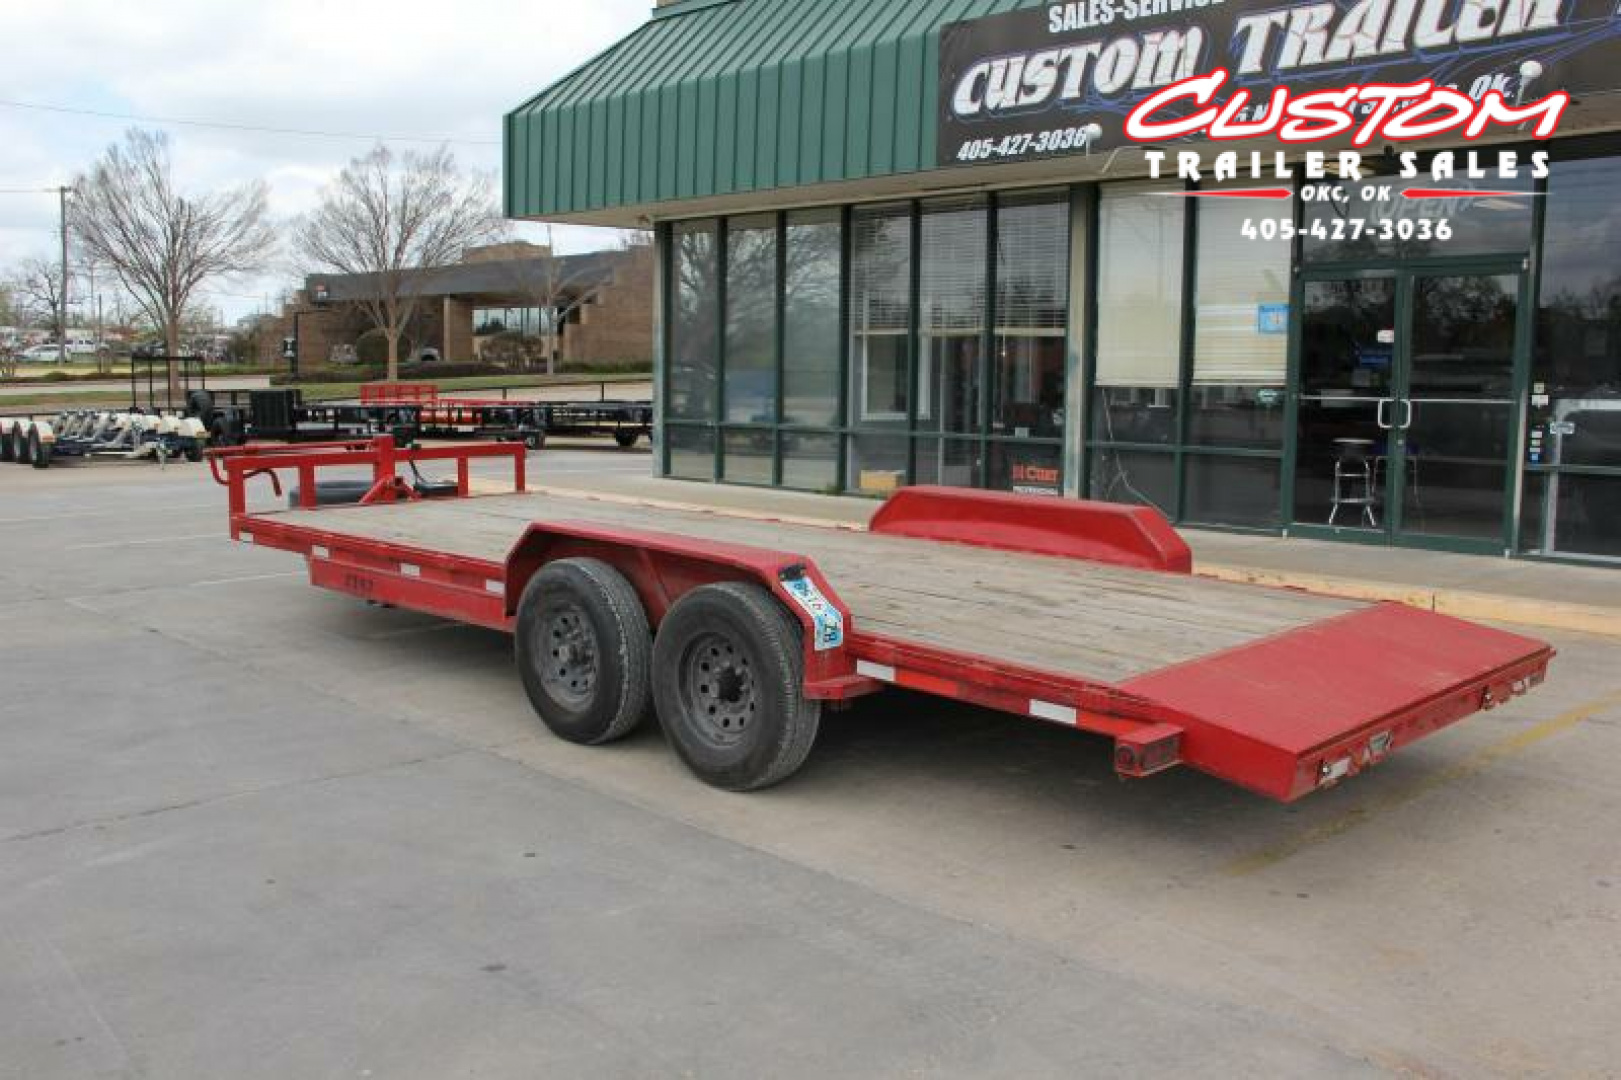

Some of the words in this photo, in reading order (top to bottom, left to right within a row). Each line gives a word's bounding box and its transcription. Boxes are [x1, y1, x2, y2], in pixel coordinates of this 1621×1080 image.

[1048, 0, 1224, 33] SALES-SER
[953, 26, 1203, 116] CUSTOM
[957, 126, 1087, 161] 405-427-3036
